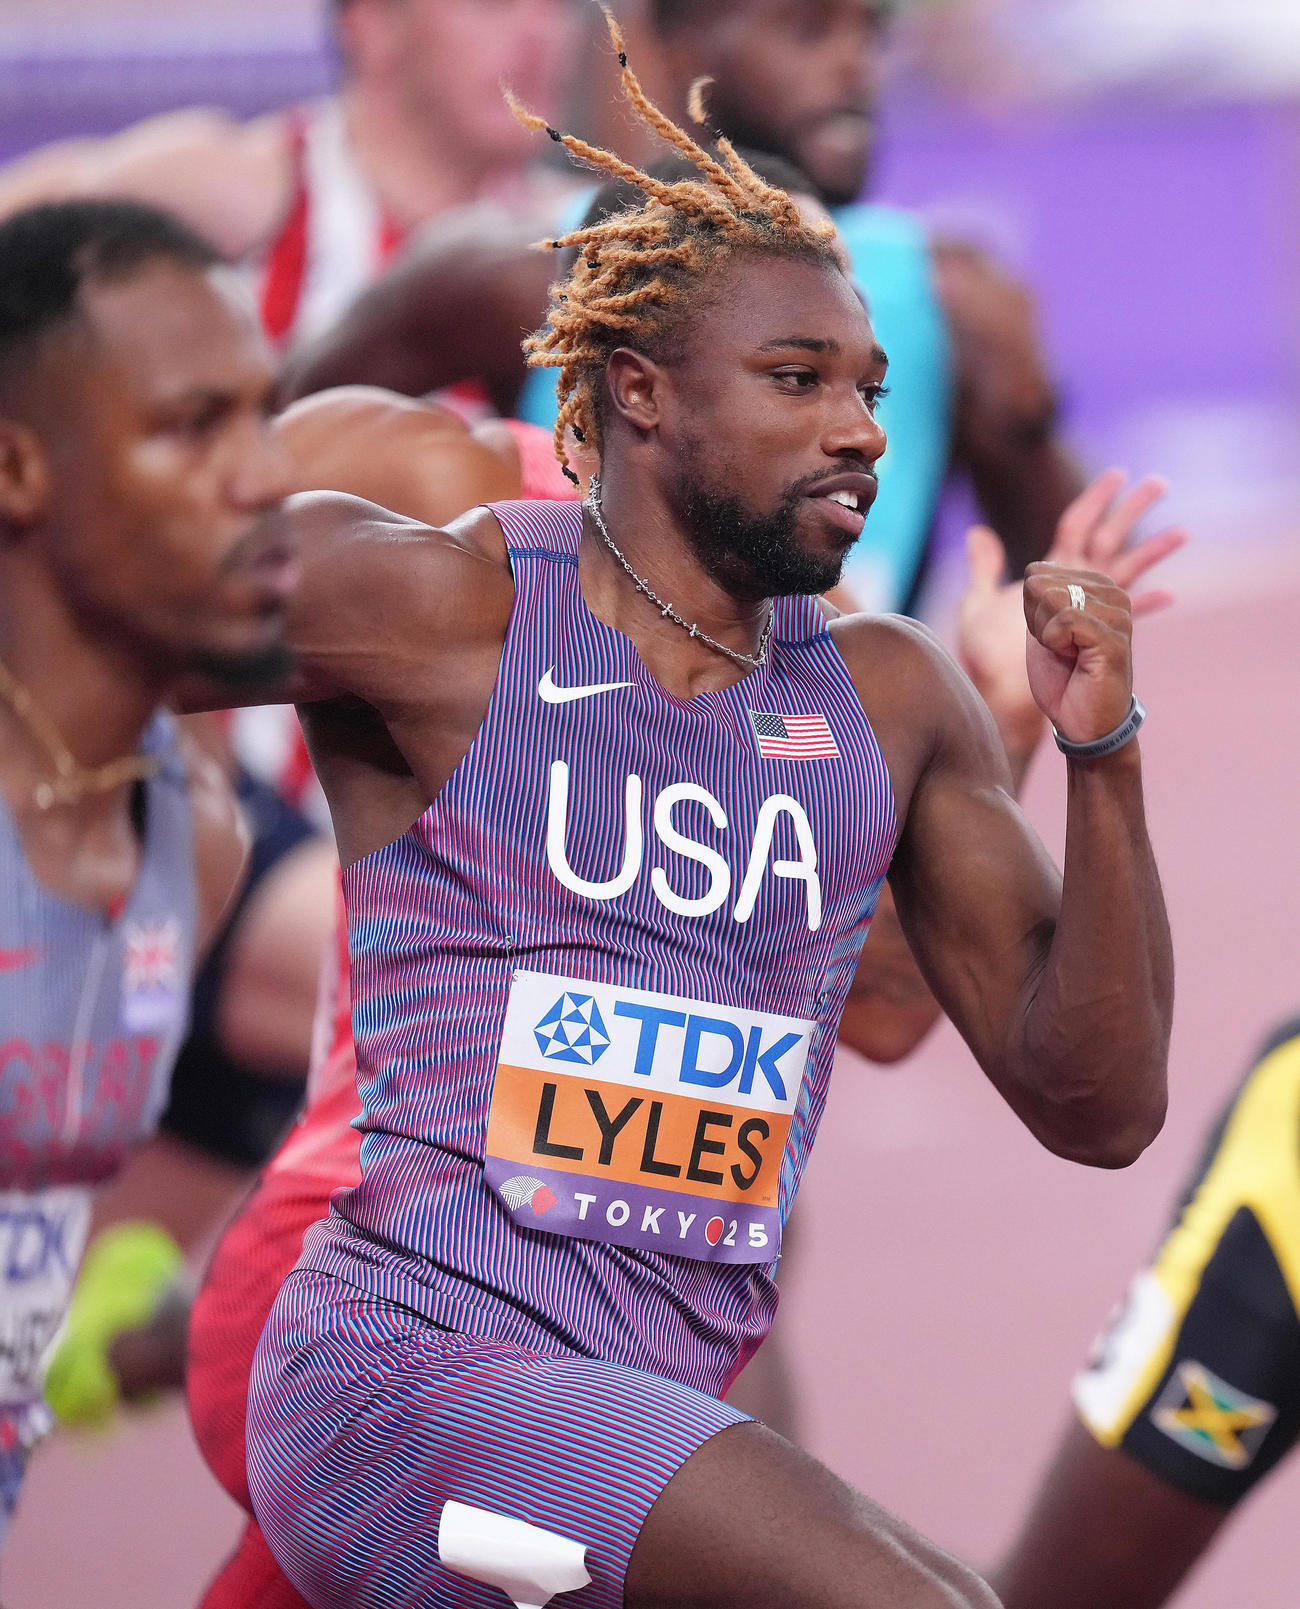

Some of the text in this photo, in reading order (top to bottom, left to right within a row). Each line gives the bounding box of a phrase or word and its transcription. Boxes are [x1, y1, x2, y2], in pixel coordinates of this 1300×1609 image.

[547, 760, 822, 932] USA
[613, 1000, 804, 1101] TDK
[532, 1082, 770, 1191] LYLES
